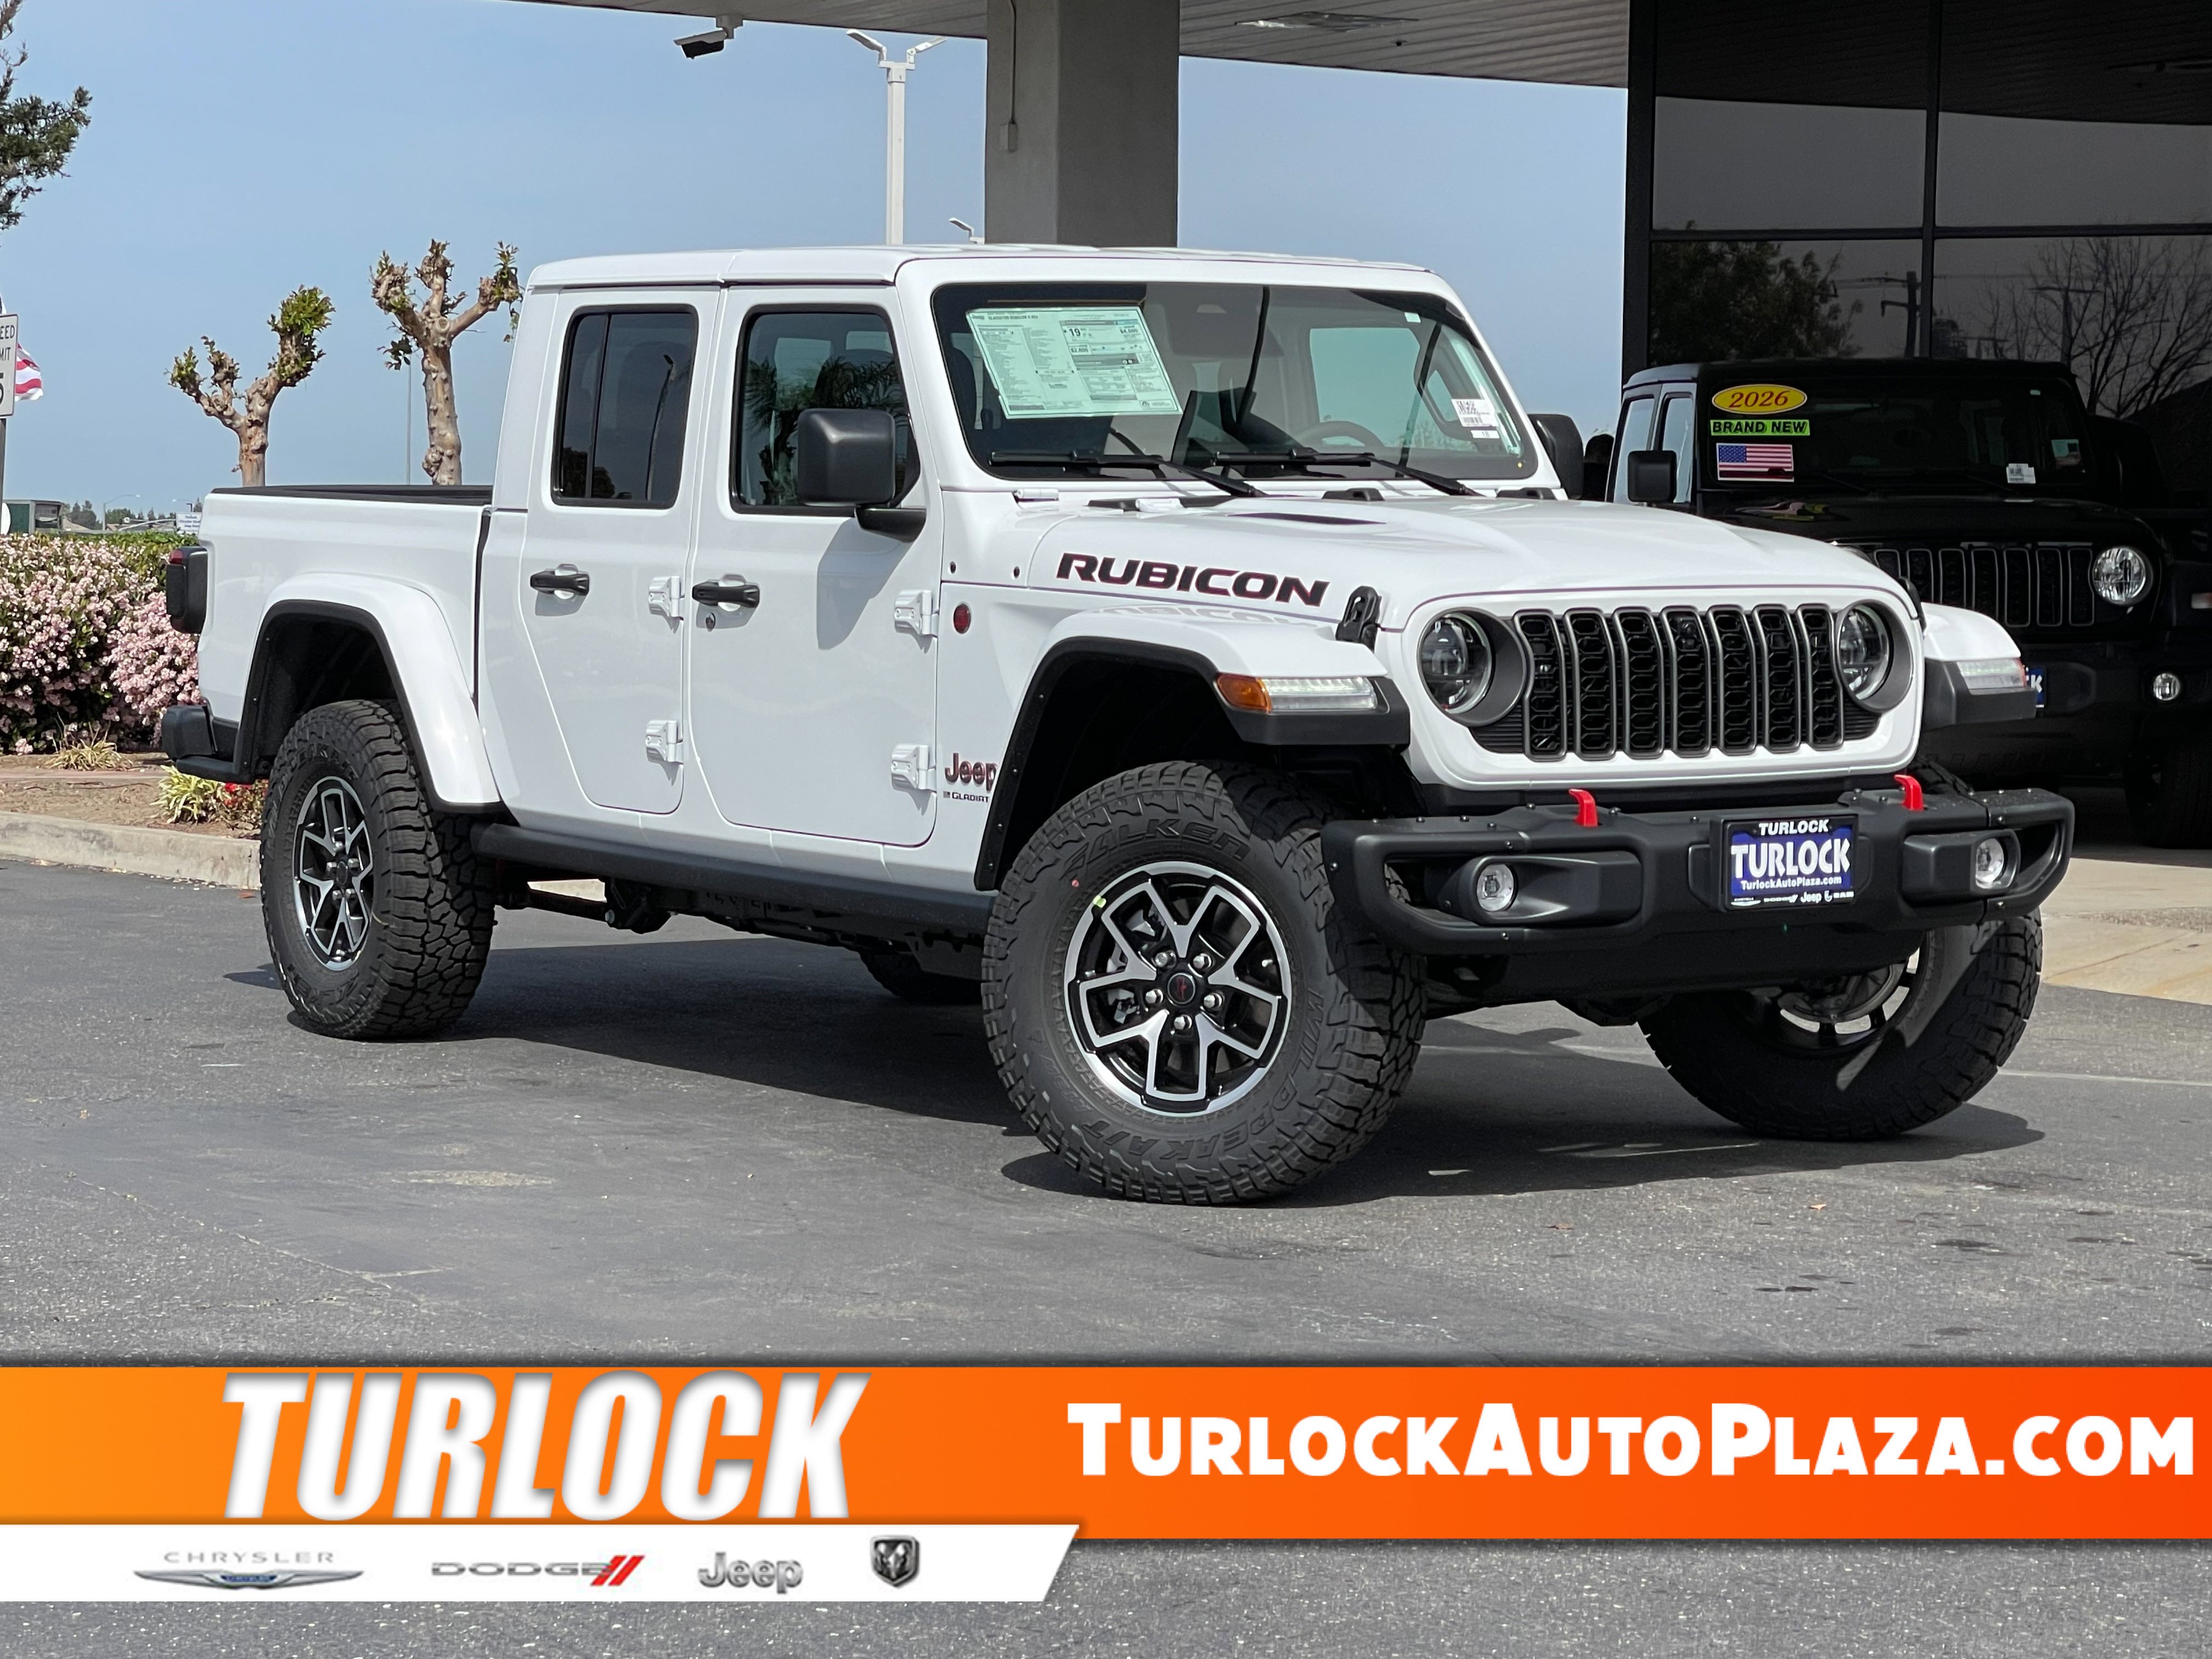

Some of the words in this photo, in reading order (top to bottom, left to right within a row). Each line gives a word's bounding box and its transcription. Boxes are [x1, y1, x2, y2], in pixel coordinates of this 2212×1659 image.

[0, 324, 15, 340] EED
[1069, 328, 1081, 336] 19
[0, 347, 10, 360] MIT
[1729, 391, 1791, 408] 2026
[1712, 421, 1766, 433] BRAND
[1771, 421, 1806, 433] NEW
[1056, 552, 1330, 607] RUBICON
[945, 753, 998, 792] Jeep
[952, 792, 990, 803] GLADIAT
[1759, 819, 1829, 836] TURLOCK
[1059, 818, 1251, 881] FALKEN
[1731, 838, 1850, 878] TURLOCK
[1740, 877, 1842, 890] TurlockAutoPlaza.com
[1801, 891, 1822, 903] Jeep
